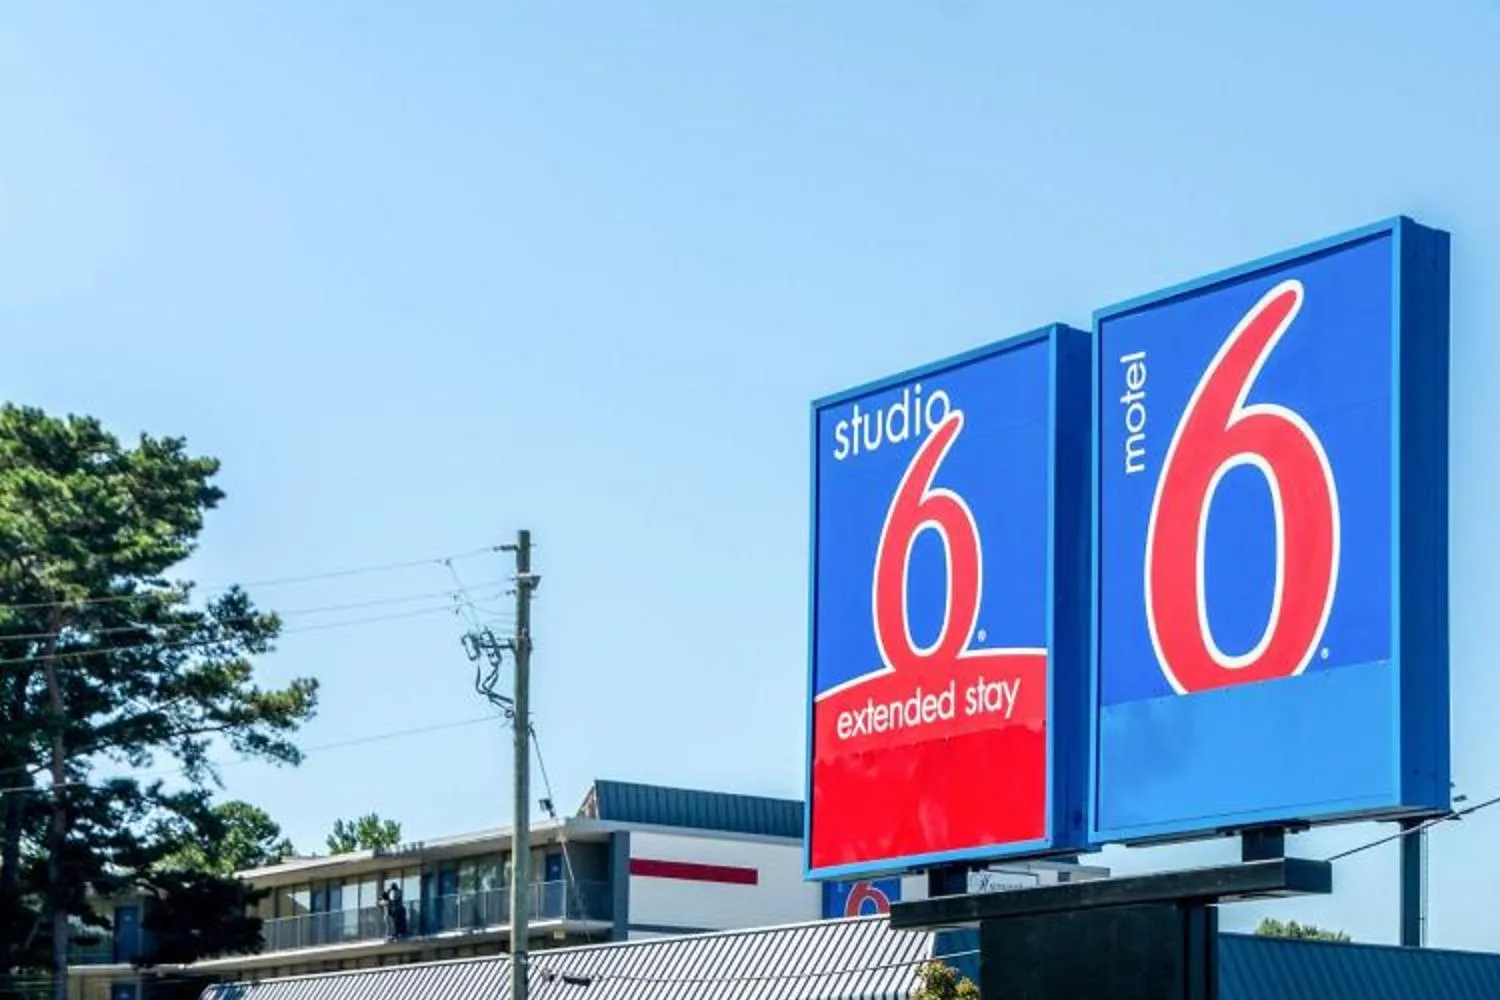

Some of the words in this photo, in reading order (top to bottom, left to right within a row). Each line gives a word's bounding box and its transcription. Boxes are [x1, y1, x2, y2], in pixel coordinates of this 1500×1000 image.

[833, 383, 951, 461] studio
[1120, 351, 1147, 474] motel
[873, 409, 983, 672] 6
[1144, 279, 1340, 695] 6
[837, 680, 955, 740] extended
[965, 676, 1021, 719] stay
